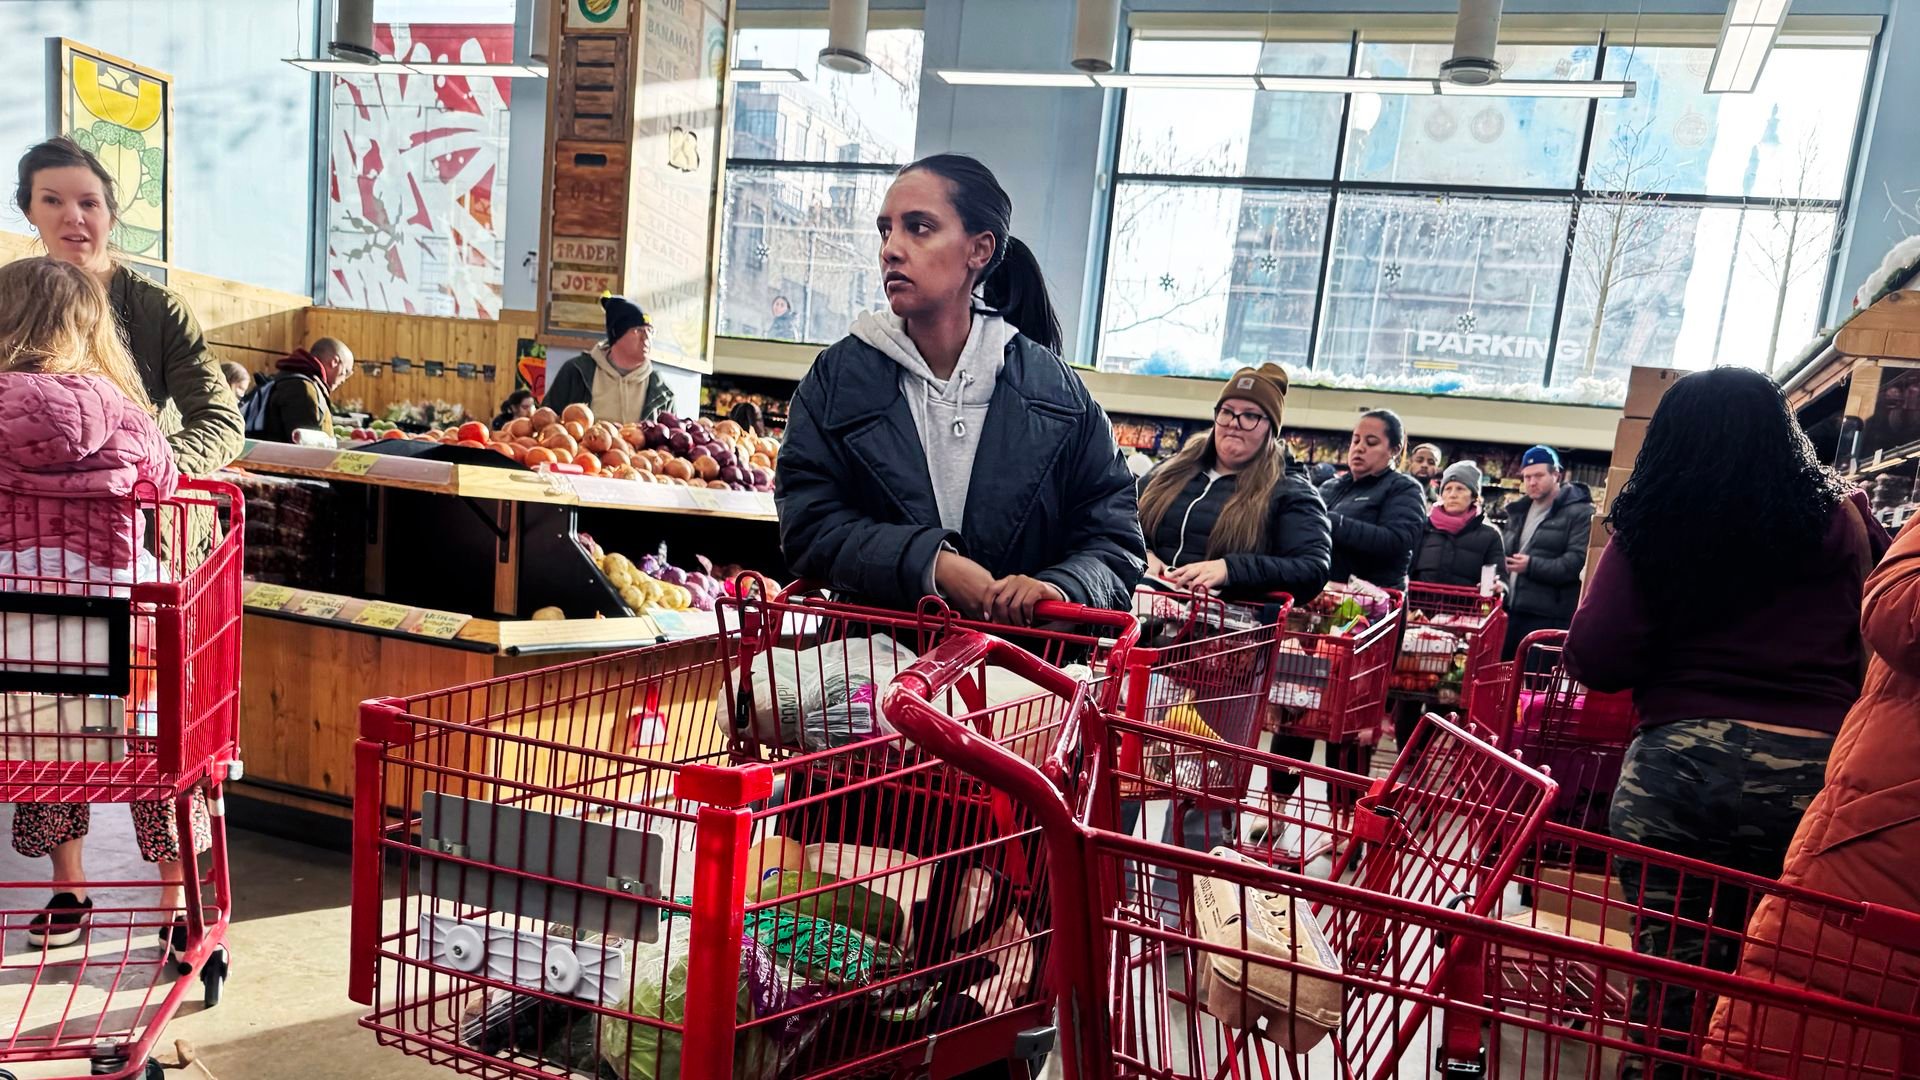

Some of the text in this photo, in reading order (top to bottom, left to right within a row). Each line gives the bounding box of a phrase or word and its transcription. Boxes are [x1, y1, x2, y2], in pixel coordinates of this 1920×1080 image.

[661, 0, 685, 17] OUR
[647, 20, 695, 57] BANANAS
[656, 55, 680, 81] ARE
[648, 214, 689, 246] THESE
[556, 243, 615, 261] TRADER
[644, 232, 689, 270] YEARS!
[560, 274, 609, 293] JOE'S
[1416, 331, 1583, 362] PARKING
